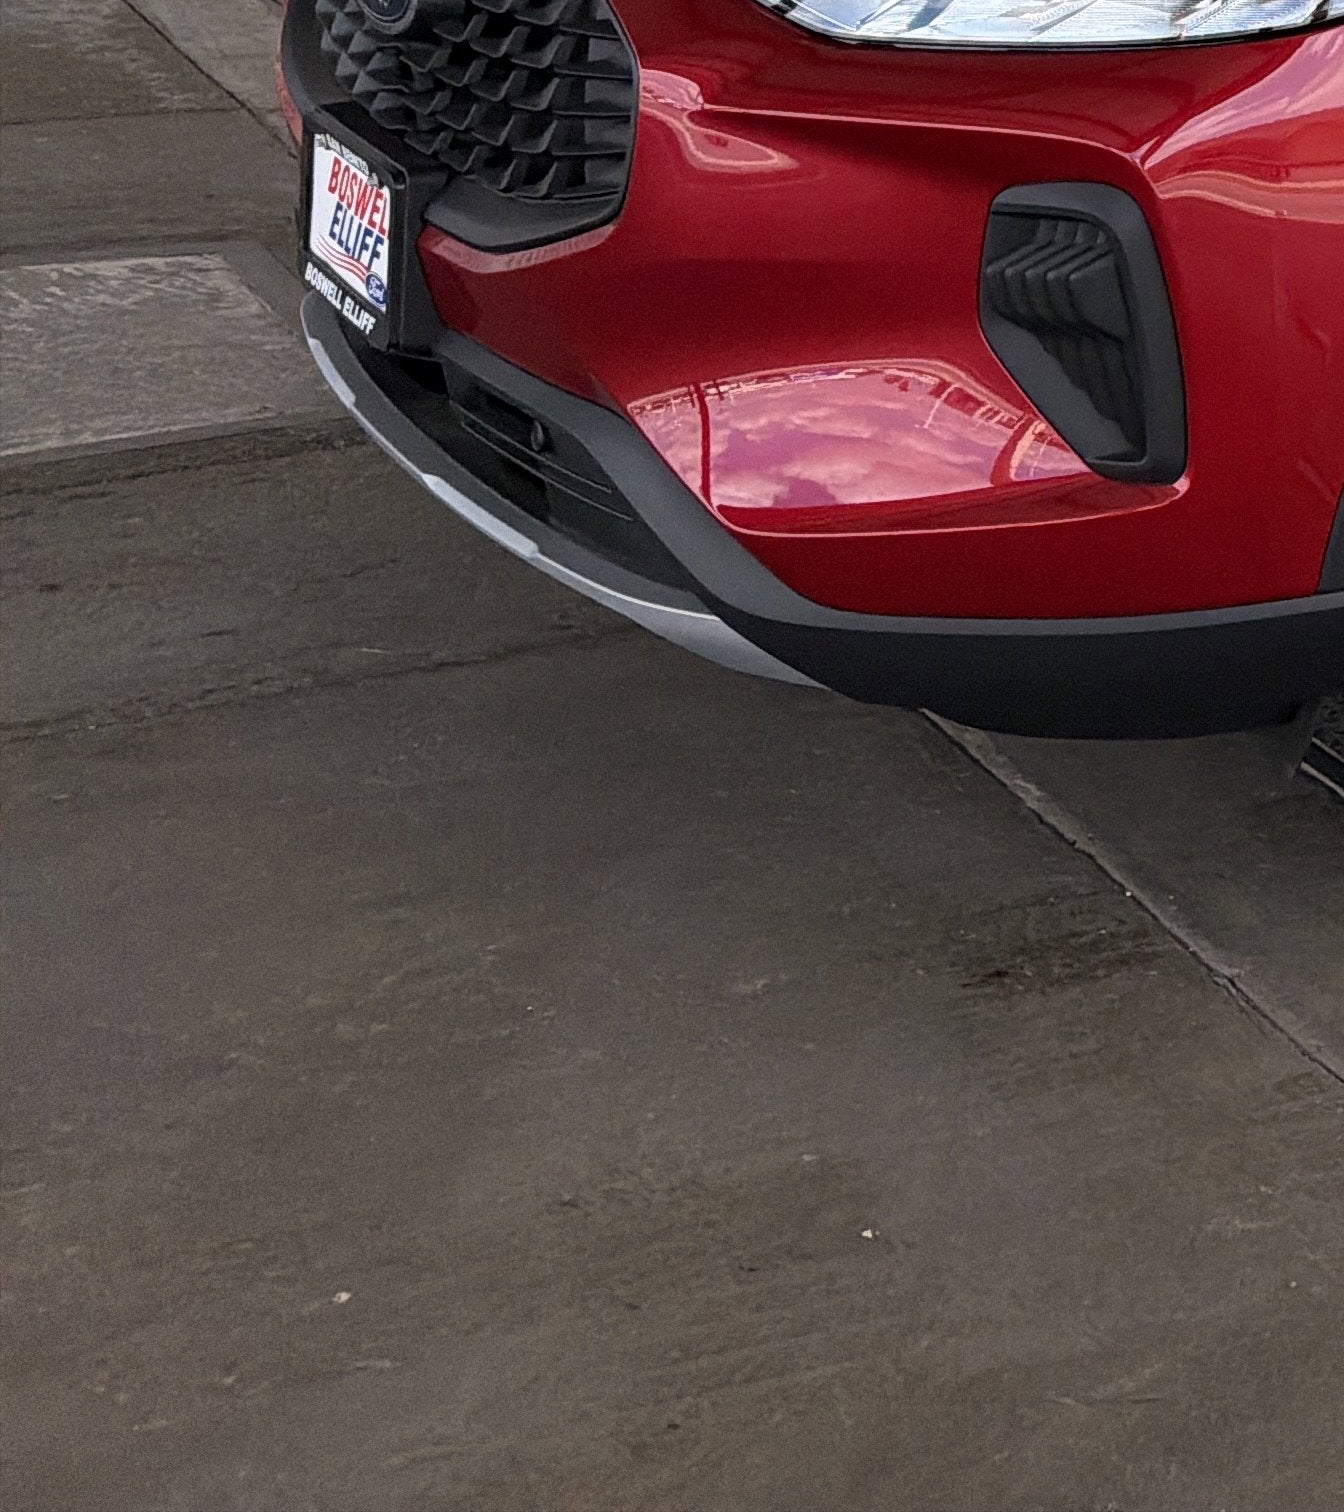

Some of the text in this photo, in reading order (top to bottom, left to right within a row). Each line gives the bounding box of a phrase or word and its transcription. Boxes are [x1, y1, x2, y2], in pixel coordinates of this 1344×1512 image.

[328, 155, 389, 240] BOSWEL
[328, 200, 385, 272] ELLIFF
[304, 261, 377, 335] BOSWELL ELLIFF
